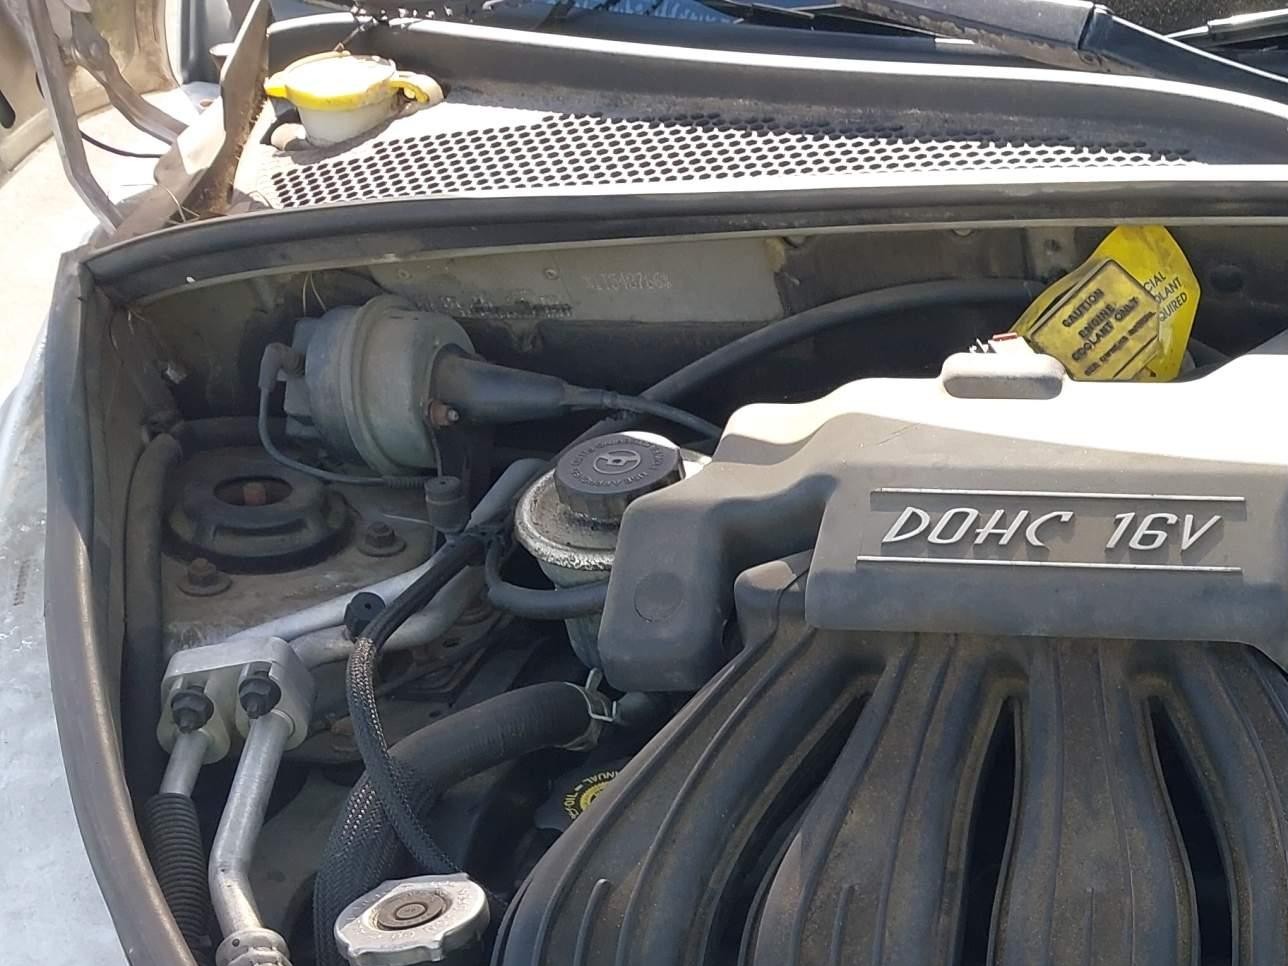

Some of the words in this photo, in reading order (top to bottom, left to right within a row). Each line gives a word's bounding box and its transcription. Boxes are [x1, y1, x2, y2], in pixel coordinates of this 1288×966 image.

[1143, 271, 1166, 292] CIAL
[1155, 277, 1182, 304] OLANT
[1062, 288, 1105, 328] CAUTION
[1078, 304, 1116, 338] ENGINE
[1159, 291, 1188, 322] QUIRED
[1071, 321, 1115, 361] COOLANT
[1114, 296, 1139, 322] ONLY
[881, 505, 1074, 548] DOHC
[1105, 511, 1222, 551] 16V
